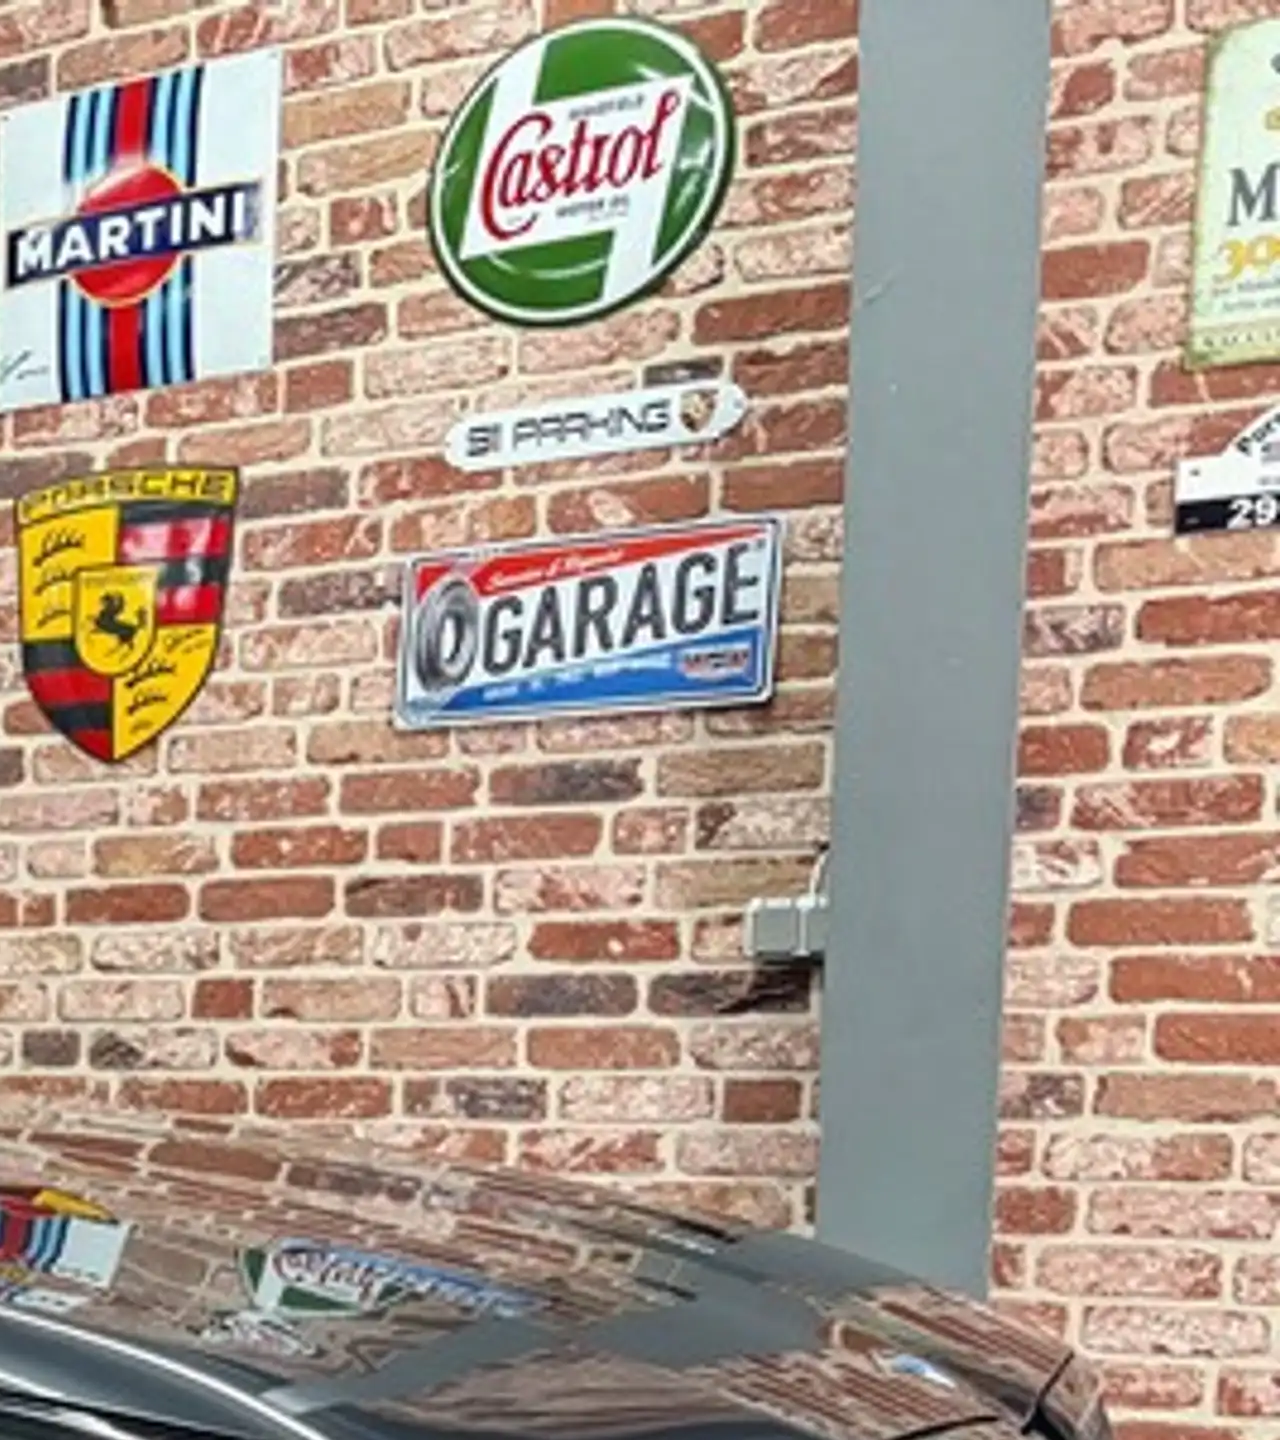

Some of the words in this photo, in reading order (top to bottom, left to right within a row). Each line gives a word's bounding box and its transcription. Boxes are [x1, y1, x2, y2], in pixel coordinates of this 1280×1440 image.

[480, 88, 681, 241] Castrol
[15, 193, 246, 276] MARTINI
[512, 399, 671, 451] PARKING
[18, 470, 233, 523] PORSCHE
[483, 543, 762, 677] GARAGE
